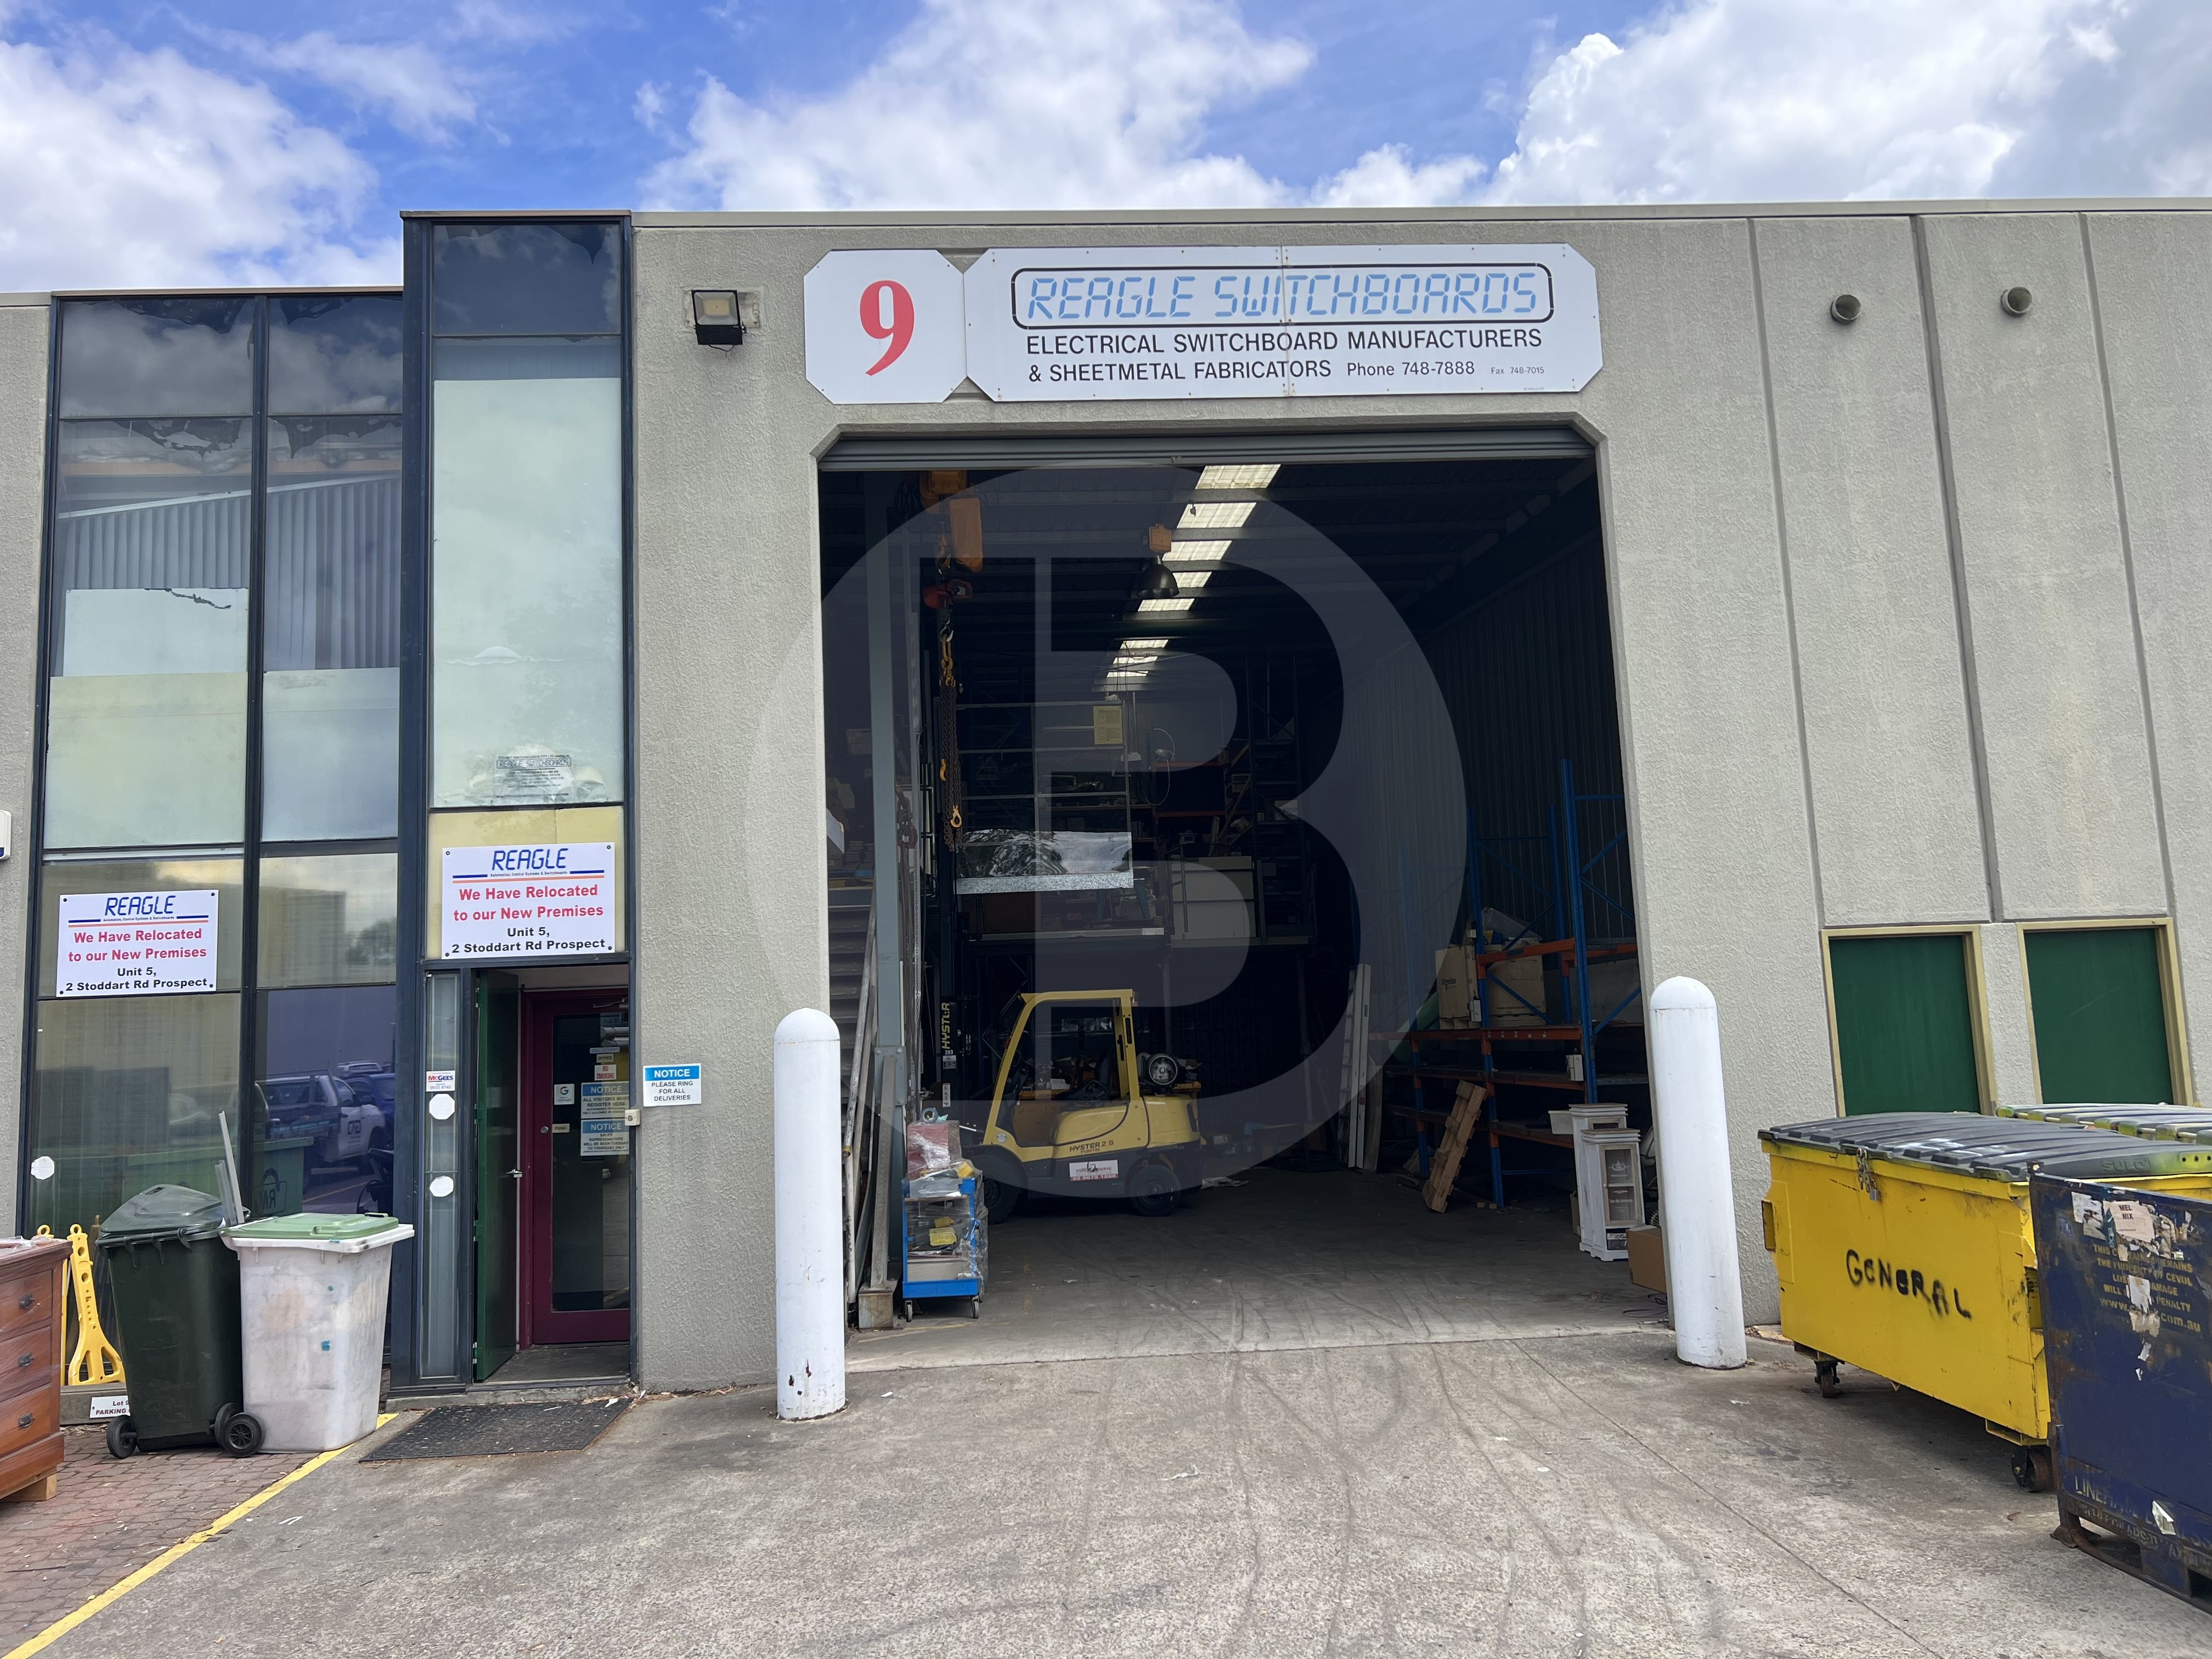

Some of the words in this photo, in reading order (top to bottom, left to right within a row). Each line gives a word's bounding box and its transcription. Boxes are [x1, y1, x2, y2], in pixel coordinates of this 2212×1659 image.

[1028, 276, 1196, 319] REAGLE
[1215, 273, 1536, 317] SWITCHBOARDS
[860, 280, 915, 376] 9
[1027, 335, 1164, 354] ELECTRICAL
[1174, 331, 1338, 353] SWITCHBOARD
[1348, 329, 1542, 349] MANUFACTURERS
[1029, 365, 1041, 382] &
[1050, 363, 1186, 381] SHEETMETAL
[1195, 360, 1331, 379] FABRICATORS
[1347, 362, 1395, 376] Phone
[1402, 361, 1475, 375] 748-7888
[527, 759, 569, 767] SWITCHBOARDS
[492, 848, 569, 871] REAGLE
[459, 888, 481, 901] We
[486, 887, 521, 900] Have
[526, 884, 598, 898] Relocated
[105, 895, 176, 916] REAGLE
[453, 909, 468, 921] to
[473, 909, 496, 921] our
[501, 906, 532, 919] New
[537, 904, 603, 918] Premises
[74, 932, 93, 943] We
[98, 931, 131, 943] Have
[136, 928, 202, 941] Relocated
[507, 927, 534, 937] Unit
[538, 926, 550, 938] 5,
[452, 944, 460, 953] 2
[464, 941, 521, 953] Stoddart
[526, 940, 542, 950] Rd
[546, 939, 606, 951] Prospect
[68, 951, 81, 962] to
[86, 951, 108, 961] our
[111, 949, 141, 961] New
[145, 947, 207, 960] Premises
[117, 967, 142, 977] Unit
[146, 966, 156, 977] 5,
[66, 982, 73, 991] 2
[77, 980, 129, 991] Stoddart
[133, 979, 149, 989] Rd
[153, 978, 207, 990] Prospect
[654, 1069, 691, 1078] NOTICE
[560, 1086, 569, 1095] G
[591, 1085, 623, 1093] NOTICE
[1070, 1141, 1101, 1152] HYSTER
[2102, 1159, 2144, 1172] SULO
[2093, 1244, 2111, 1255] THIS
[2097, 1257, 2112, 1268] THE
[2112, 1273, 2129, 1284] LOS
[2103, 1284, 2122, 1295] WILL
[2155, 1296, 2191, 1313] PENALTY
